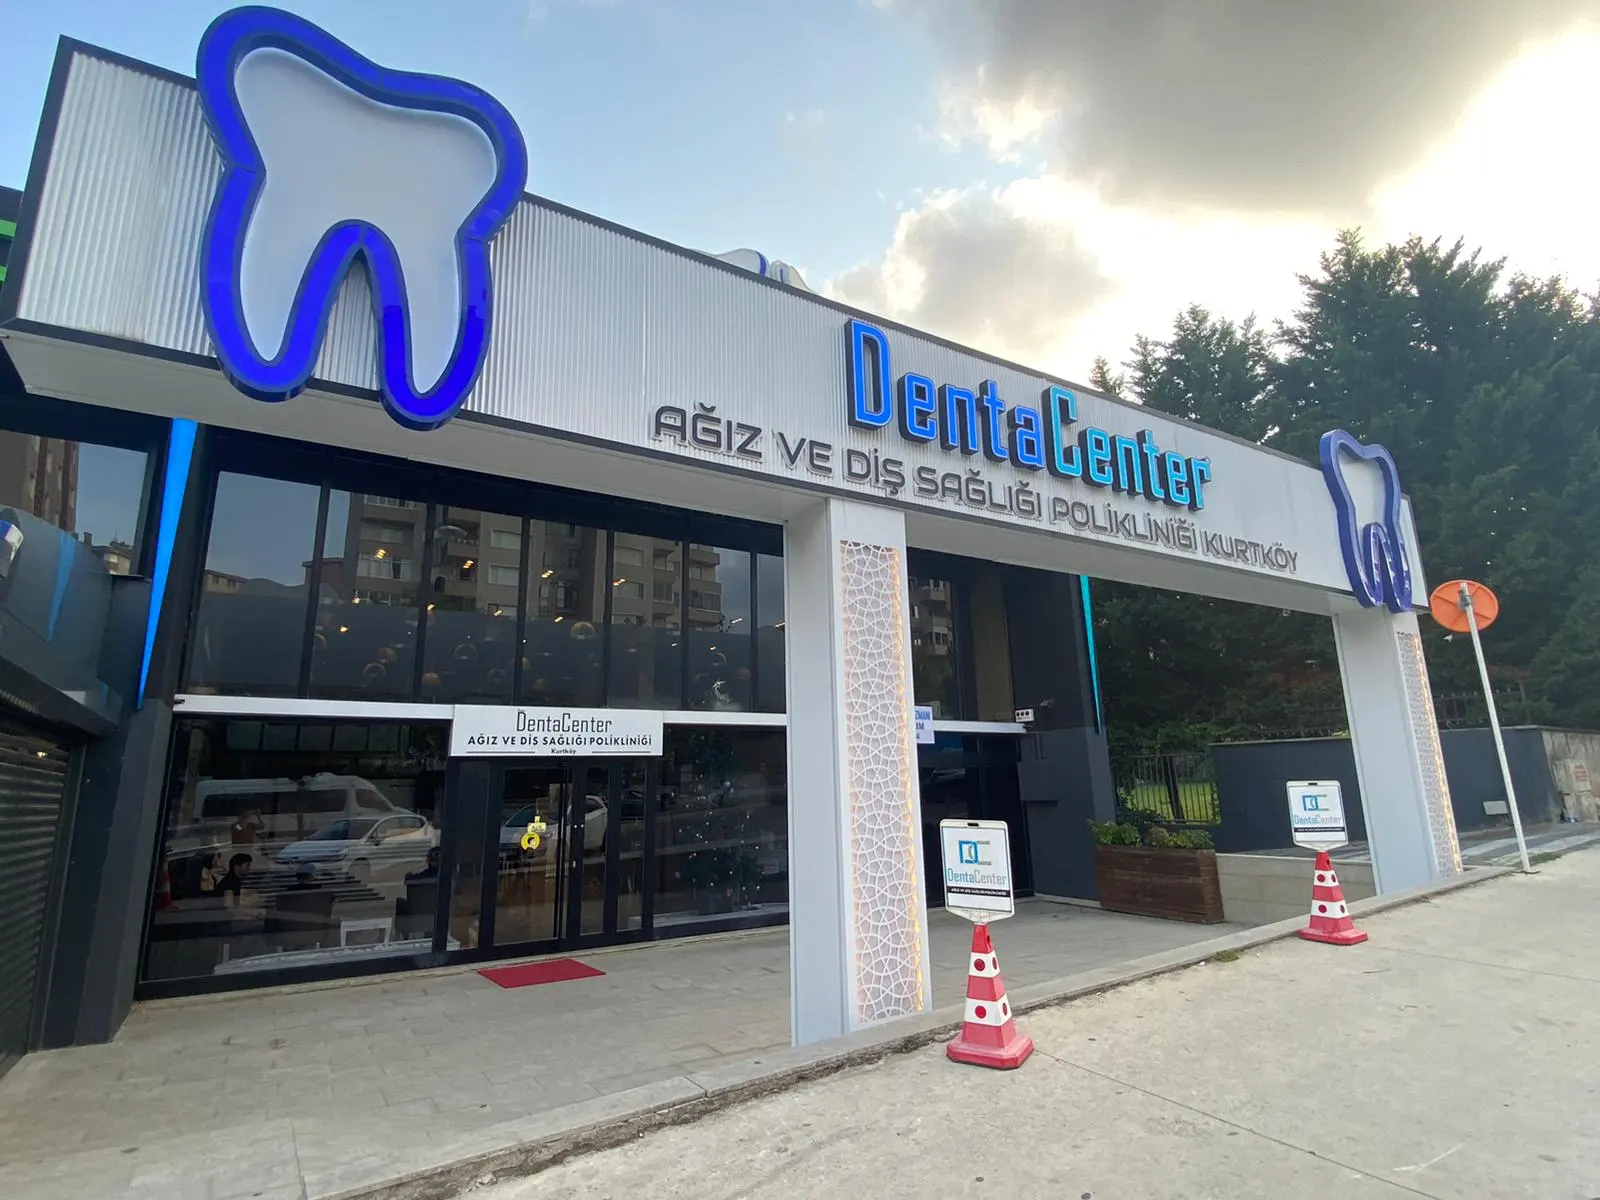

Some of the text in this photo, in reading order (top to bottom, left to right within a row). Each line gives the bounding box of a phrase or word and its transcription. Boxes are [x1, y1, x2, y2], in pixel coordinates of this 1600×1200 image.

[845, 319, 1211, 512] DentaCenter
[653, 402, 1298, 573] AĞIZ VE DİŞ SAĞLIĞI POLİKLİNİĞİ KURTKÖY
[516, 711, 612, 733] DentaCenter
[467, 733, 498, 745] AĞIZ
[502, 736, 516, 745] VE
[542, 734, 587, 746] SAĞLIĞI
[946, 868, 1008, 886] DentaCenter
